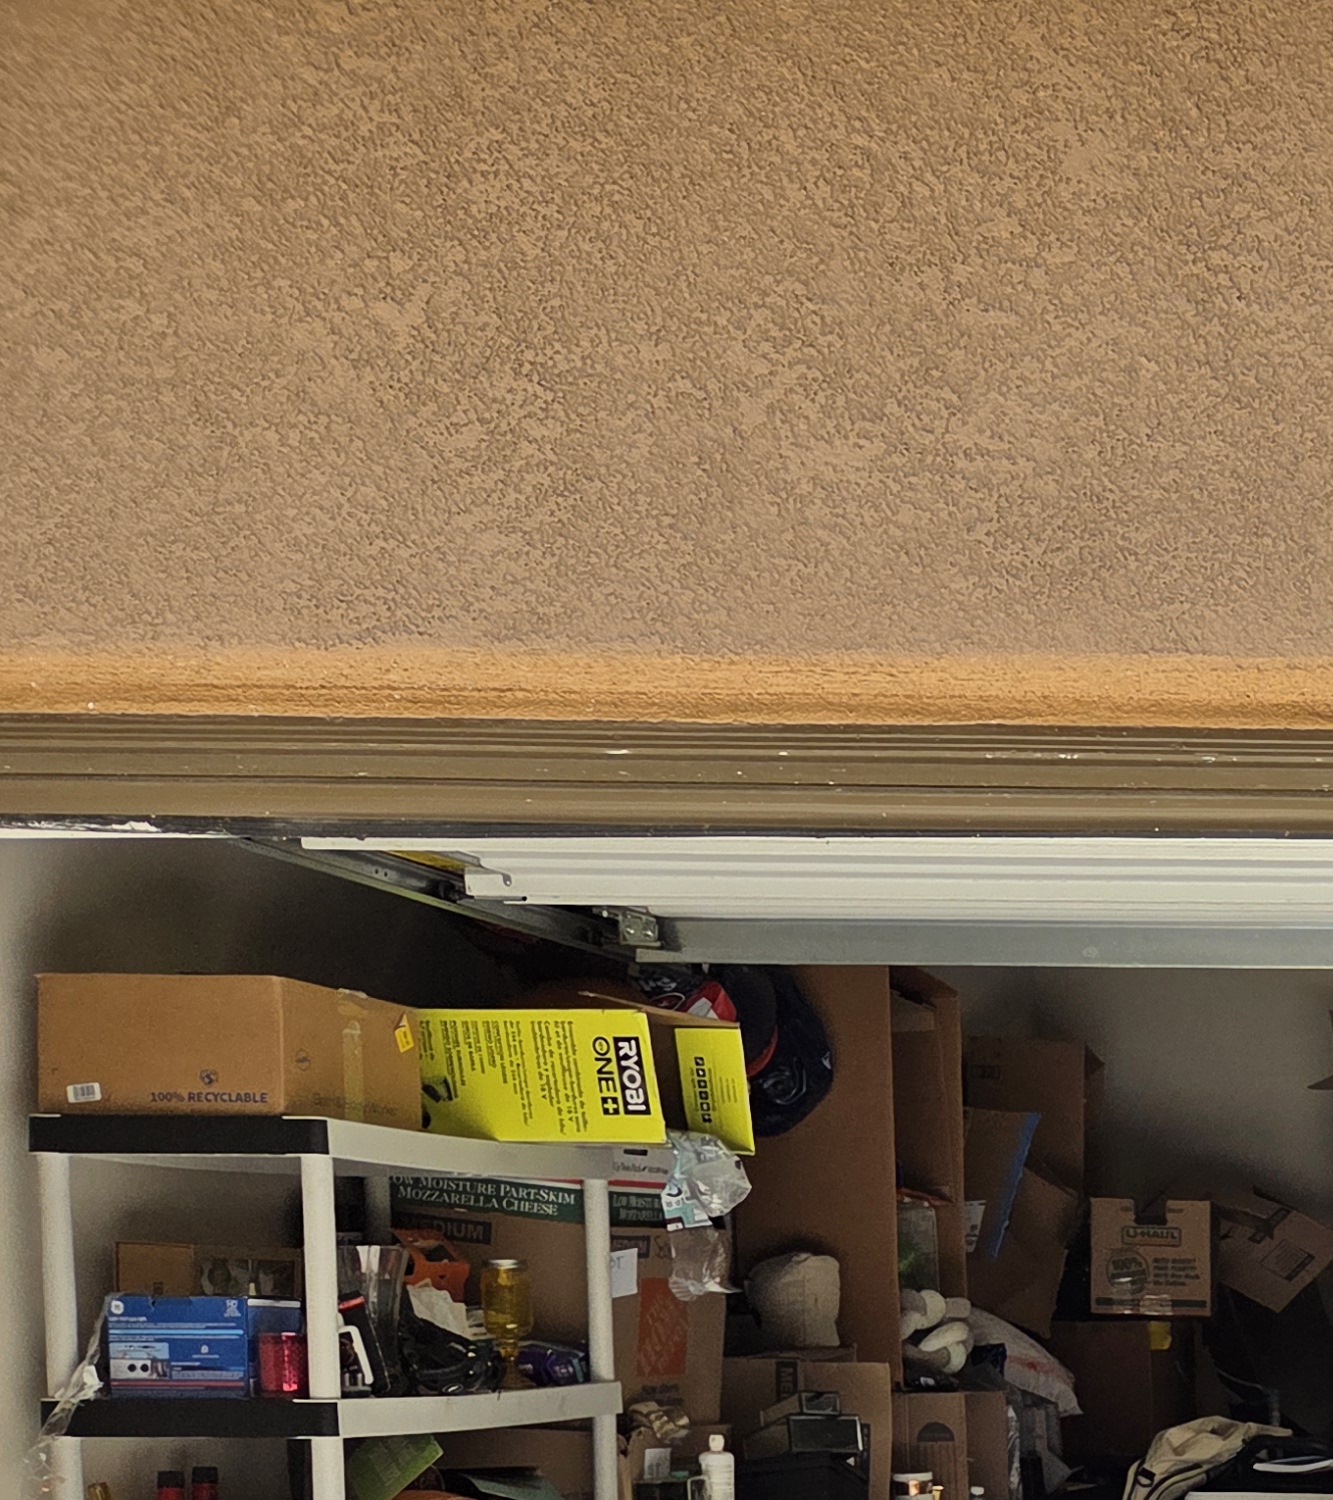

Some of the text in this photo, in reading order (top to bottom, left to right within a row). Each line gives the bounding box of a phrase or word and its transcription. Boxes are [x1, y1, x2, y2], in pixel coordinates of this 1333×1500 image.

[592, 1036, 620, 1116] ONE+
[616, 1038, 647, 1112] RYOBI
[187, 1091, 268, 1104] RECYCLABLE
[397, 1185, 559, 1217] MOZZARELLA CHEESE
[418, 1175, 497, 1196] MOISTURE
[499, 1183, 576, 1206] PART-SKIM
